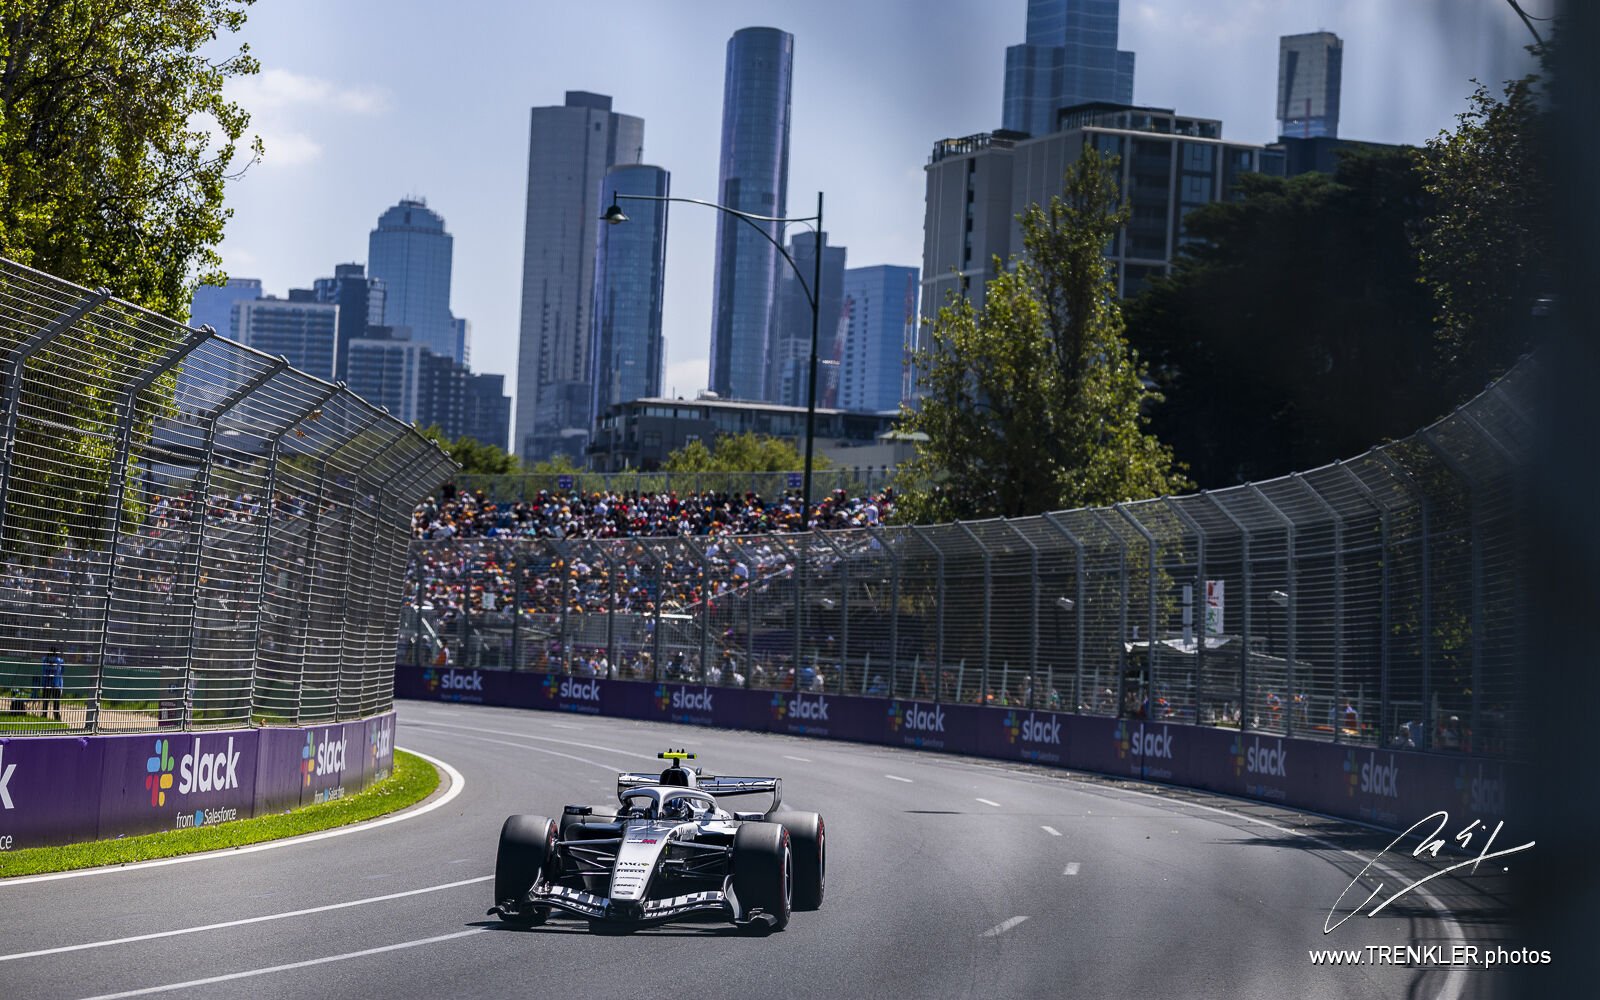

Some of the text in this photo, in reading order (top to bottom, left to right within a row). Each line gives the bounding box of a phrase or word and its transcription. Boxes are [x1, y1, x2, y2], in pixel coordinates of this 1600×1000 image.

[441, 669, 483, 691] slack
[561, 677, 600, 701] slack
[672, 686, 712, 711] slack
[788, 694, 828, 720] slack
[905, 703, 945, 732] slack
[1022, 712, 1061, 745] slack
[316, 727, 347, 776] slack
[1131, 723, 1172, 759] slack
[1247, 736, 1287, 777] slack
[179, 736, 240, 794] slack
[1361, 752, 1398, 798] slack
[176, 806, 237, 829] from Salesforce
